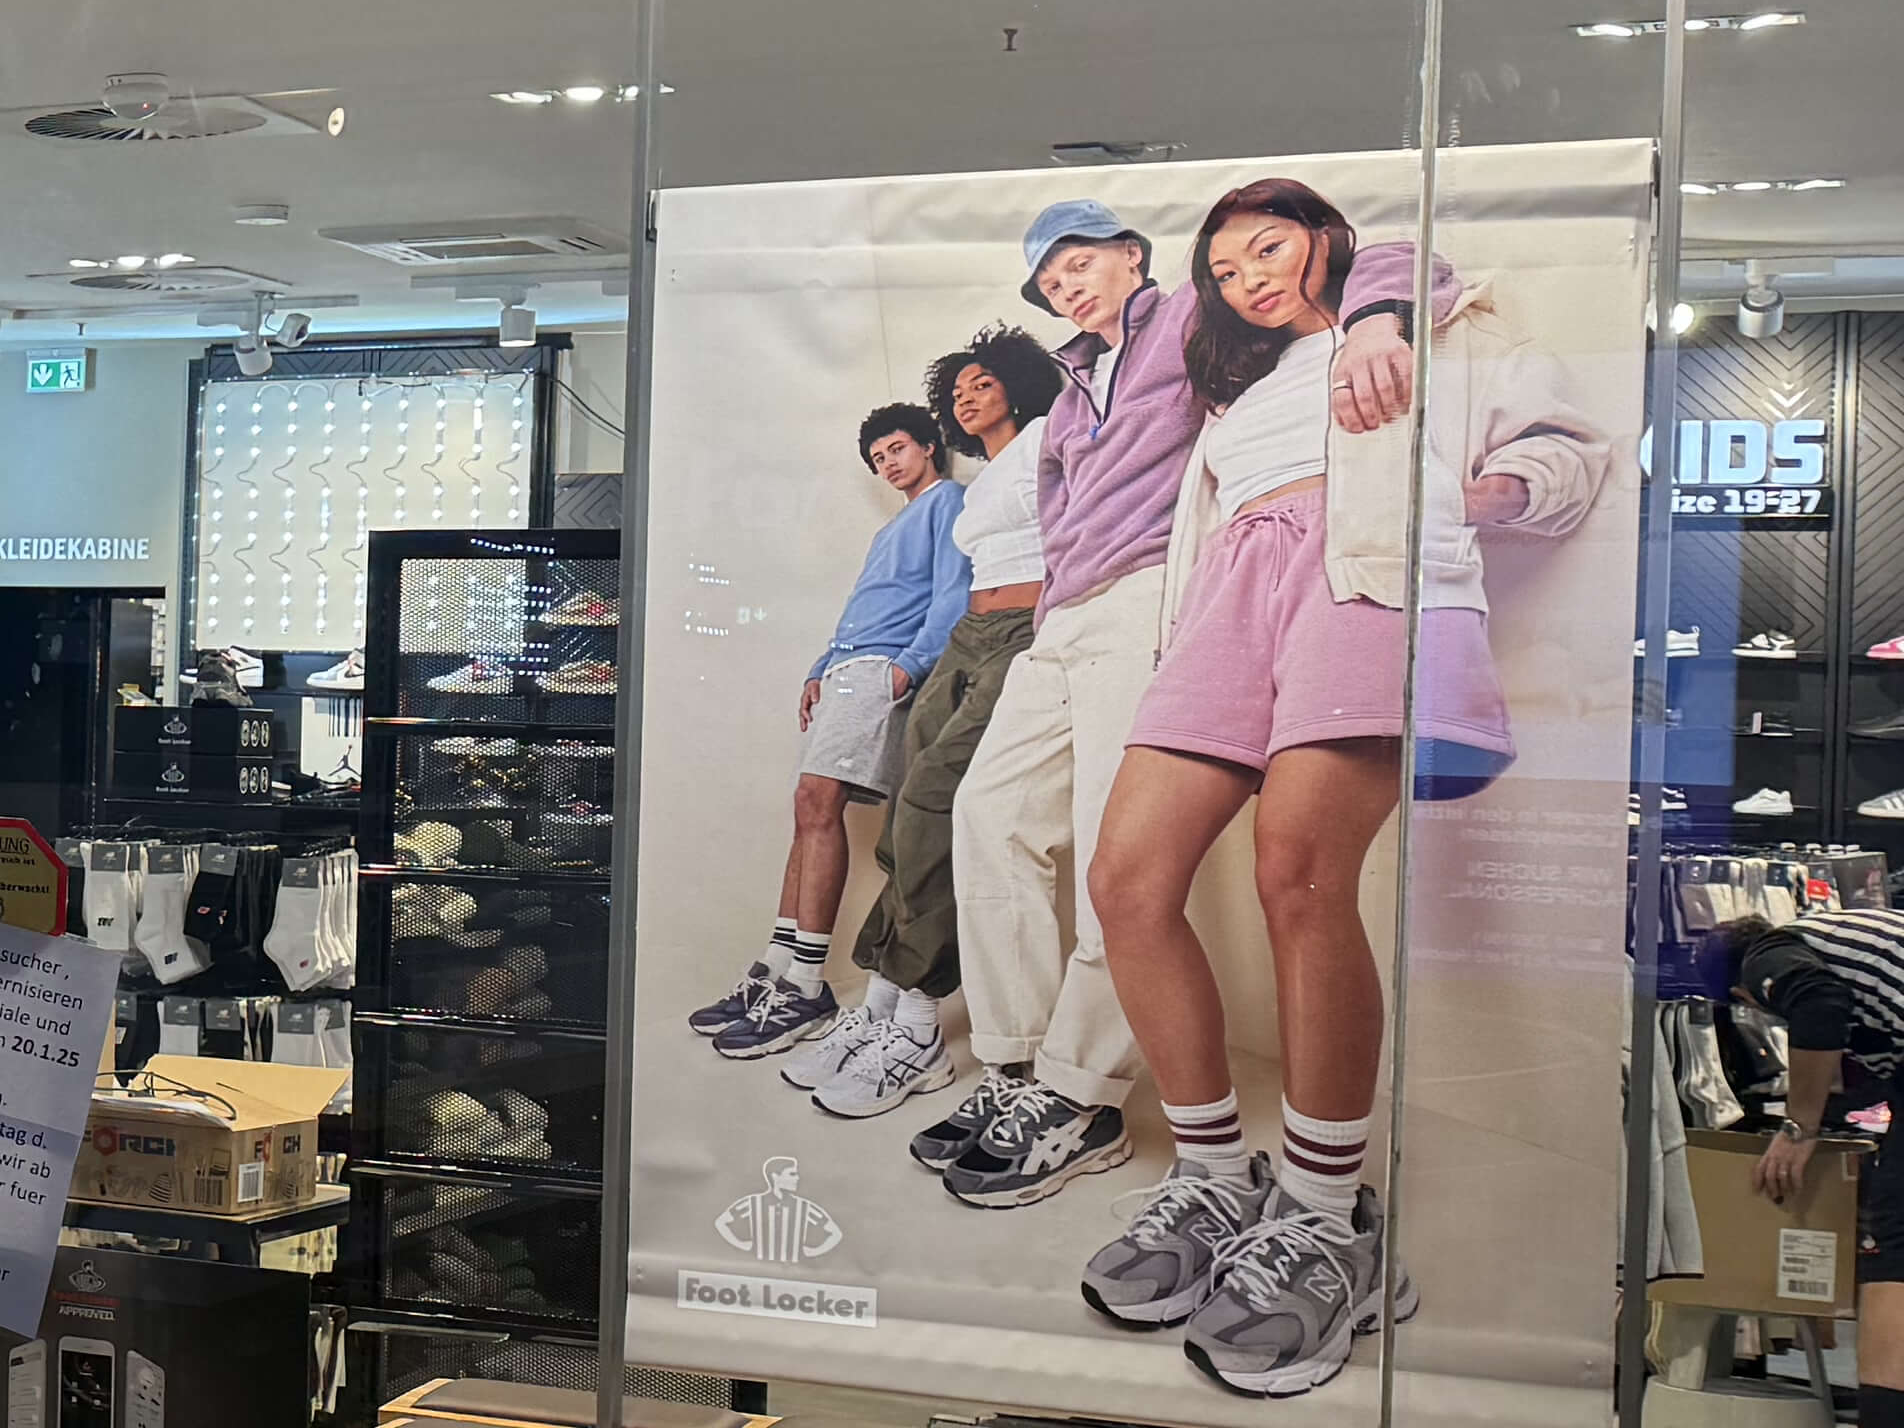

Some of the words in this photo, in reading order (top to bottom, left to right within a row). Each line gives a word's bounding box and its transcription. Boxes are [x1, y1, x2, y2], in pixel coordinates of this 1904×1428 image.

[1671, 489, 1718, 513] ize
[36, 1016, 71, 1036] und
[11, 1035, 80, 1067] 20.1.25
[31, 1131, 48, 1150] d.
[29, 1161, 52, 1179] ab
[10, 1181, 48, 1206] fuer
[685, 1277, 752, 1308] Foot
[762, 1285, 869, 1319] Locker
